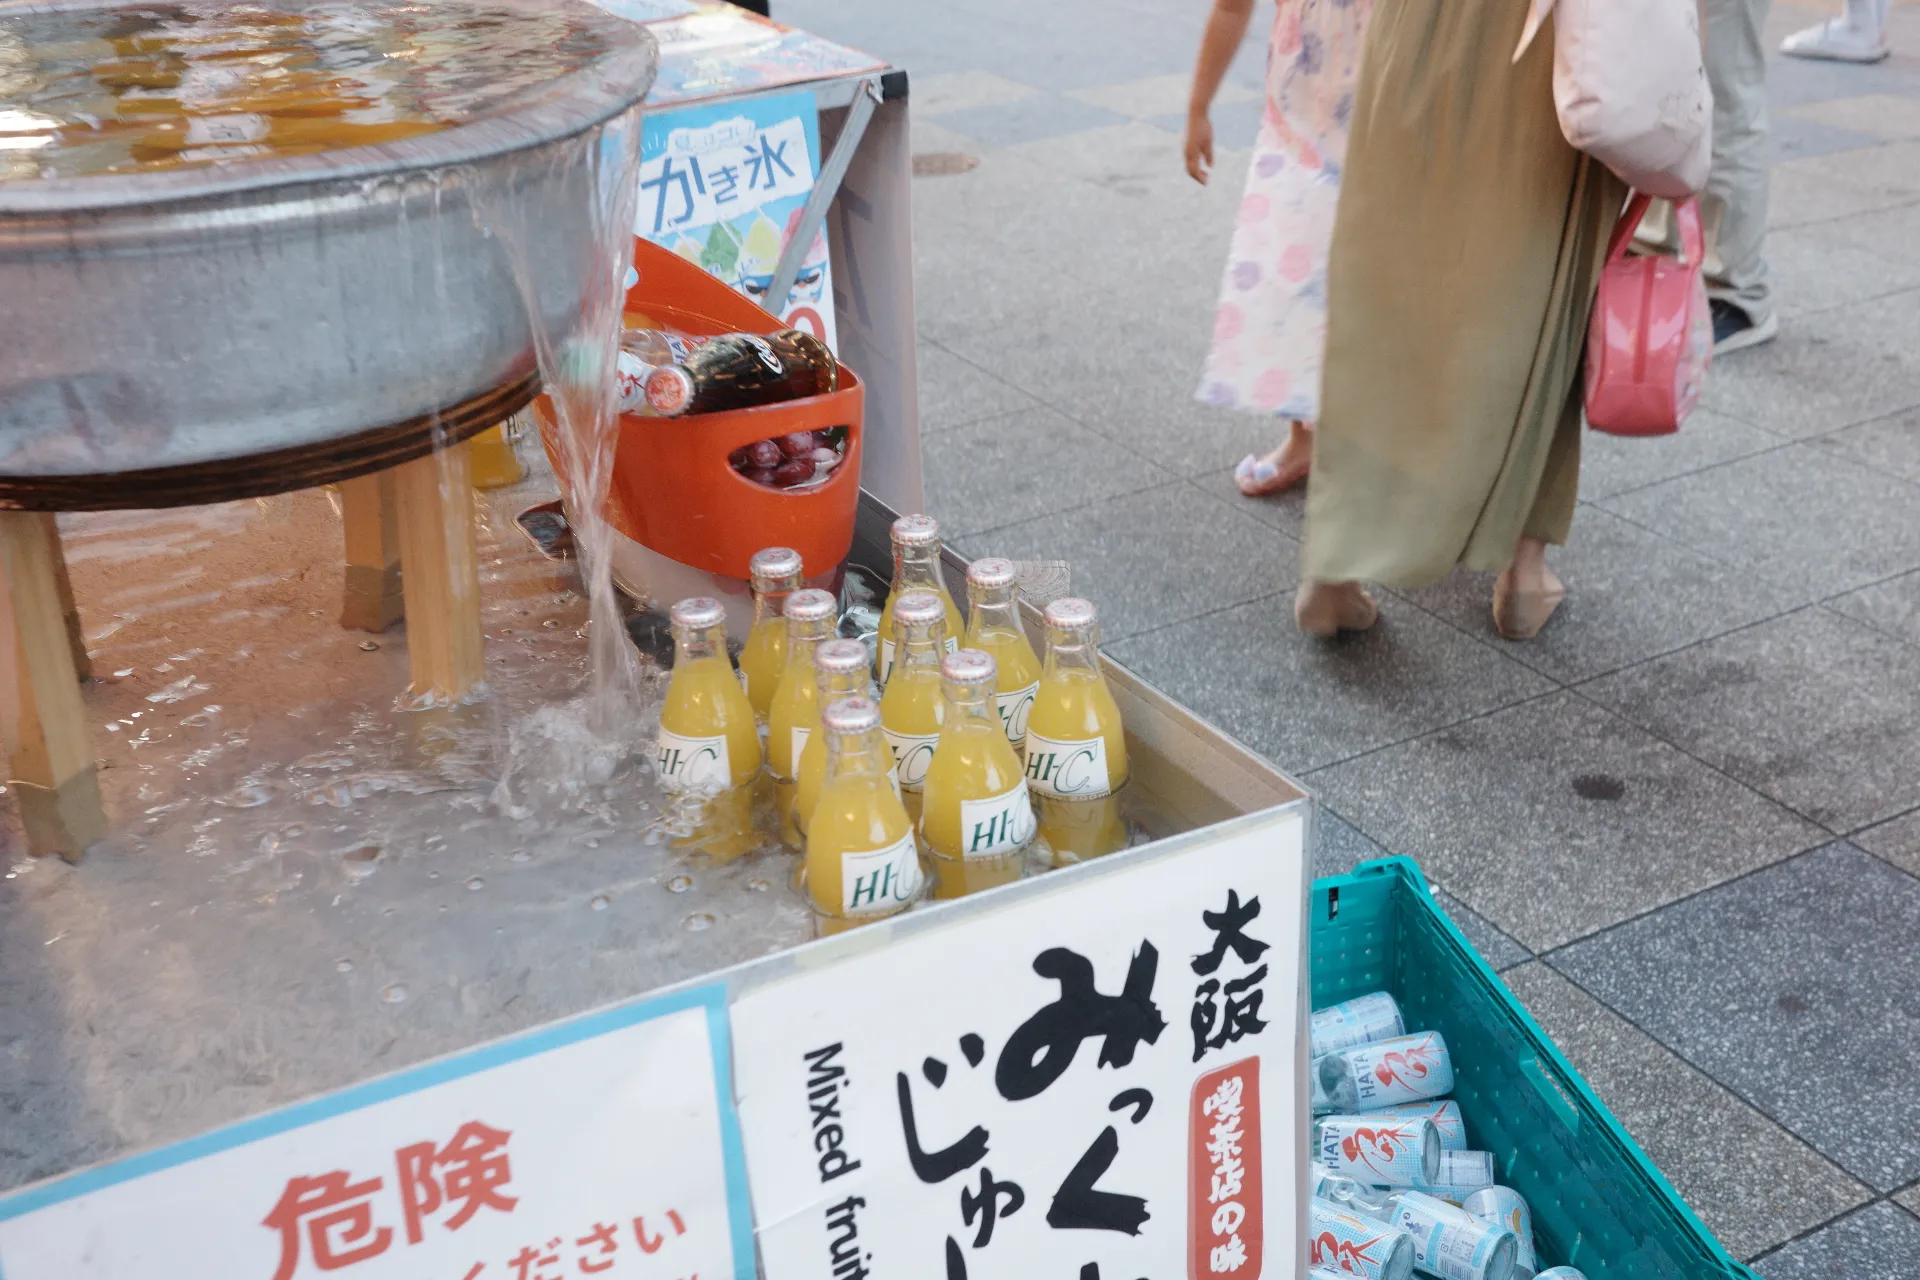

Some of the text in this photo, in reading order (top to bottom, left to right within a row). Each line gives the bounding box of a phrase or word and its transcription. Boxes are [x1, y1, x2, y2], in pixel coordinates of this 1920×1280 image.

[641, 133, 796, 233] かき氷
[1025, 744, 1098, 794] HI-C
[1190, 888, 1271, 1063] 大阪
[803, 1042, 862, 1184] Mixed
[995, 938, 1168, 1280] みっく
[1203, 1076, 1248, 1273] 喫茶店の味
[263, 1120, 520, 1280] 危険
